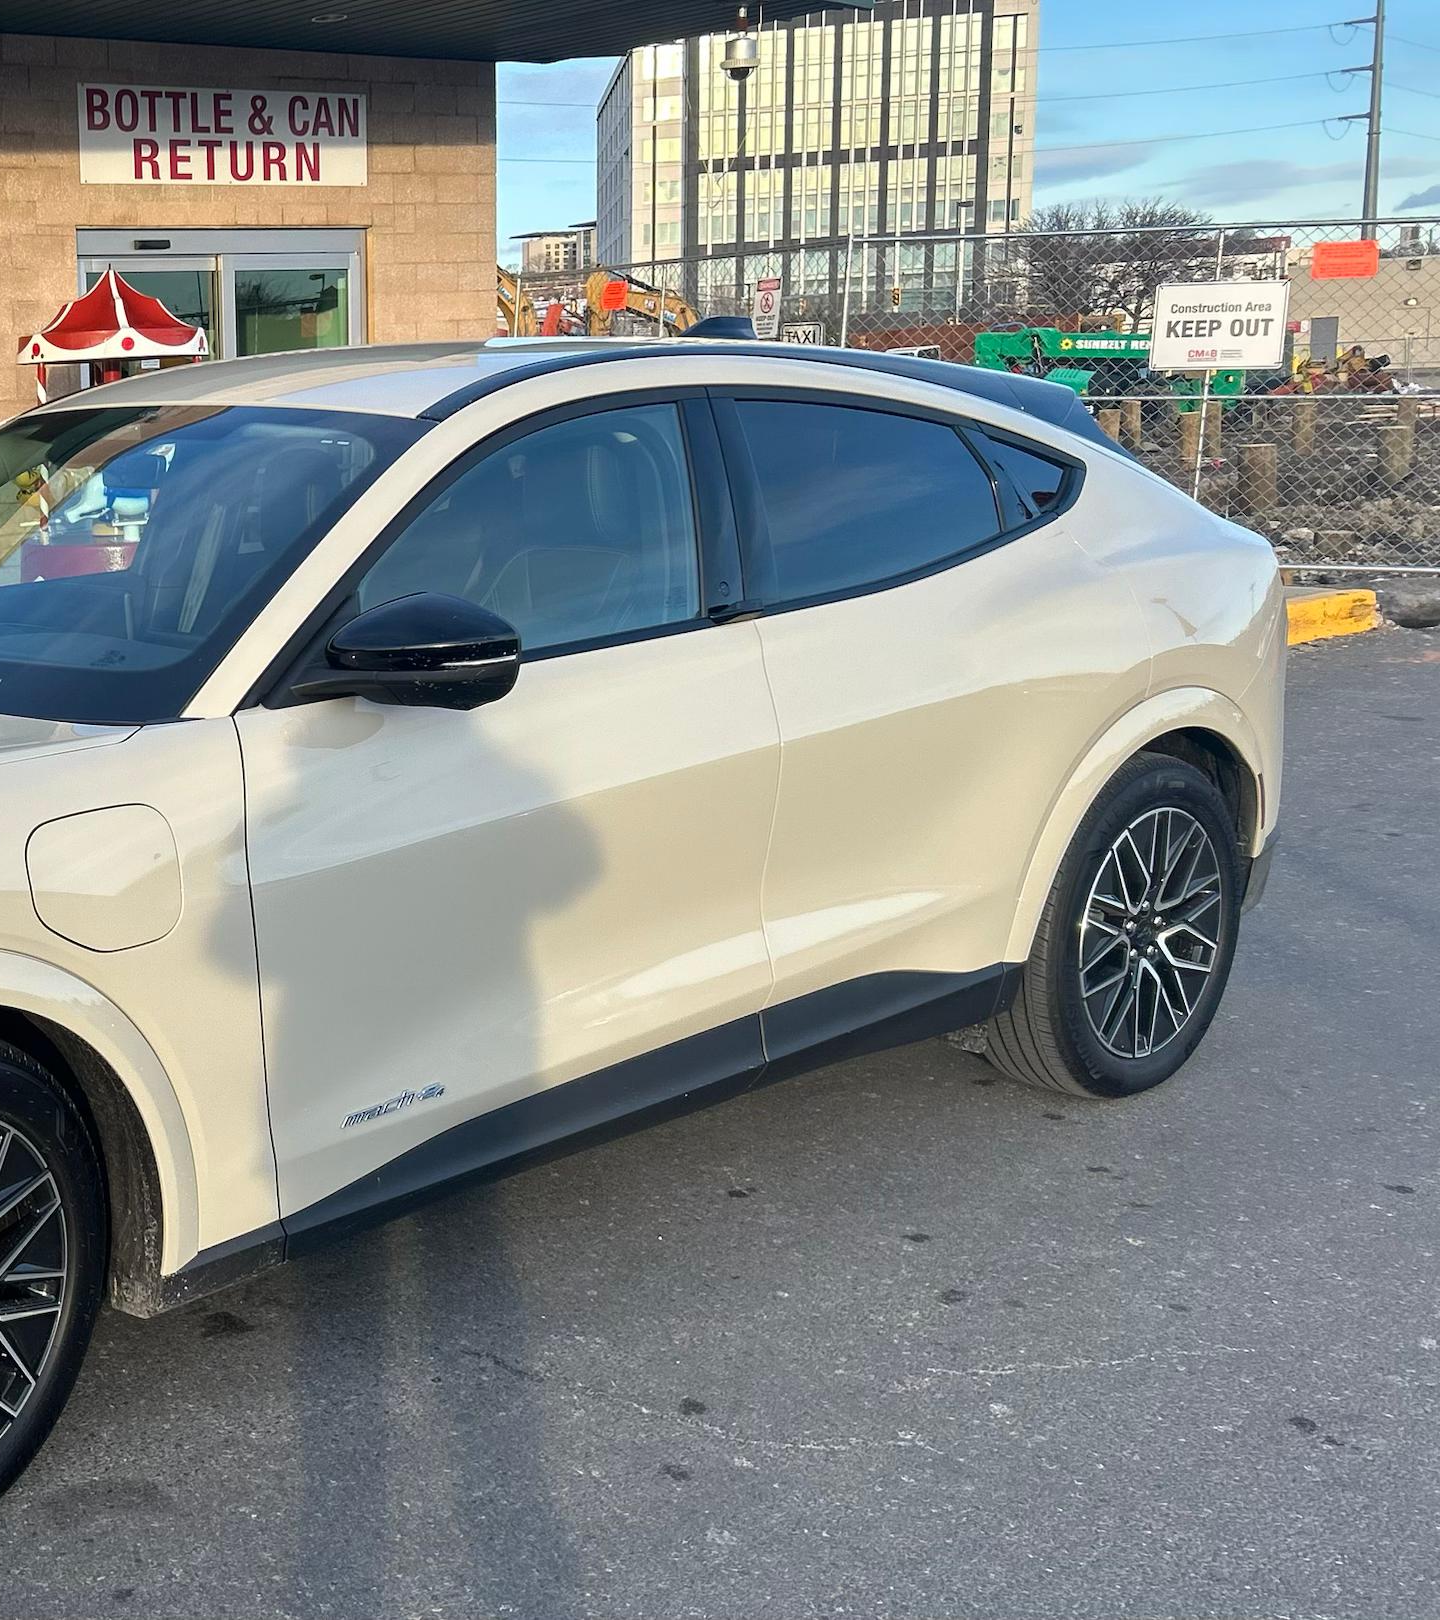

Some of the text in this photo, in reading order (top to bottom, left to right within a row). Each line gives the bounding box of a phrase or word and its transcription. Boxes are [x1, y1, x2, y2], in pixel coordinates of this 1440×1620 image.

[85, 87, 360, 138] BOTTLE & CAN
[132, 138, 321, 182] RETURN
[1170, 301, 1273, 315] Construction Area
[785, 329, 816, 344] TAXI
[1165, 318, 1222, 339] KEEP
[1229, 317, 1275, 337] OUT
